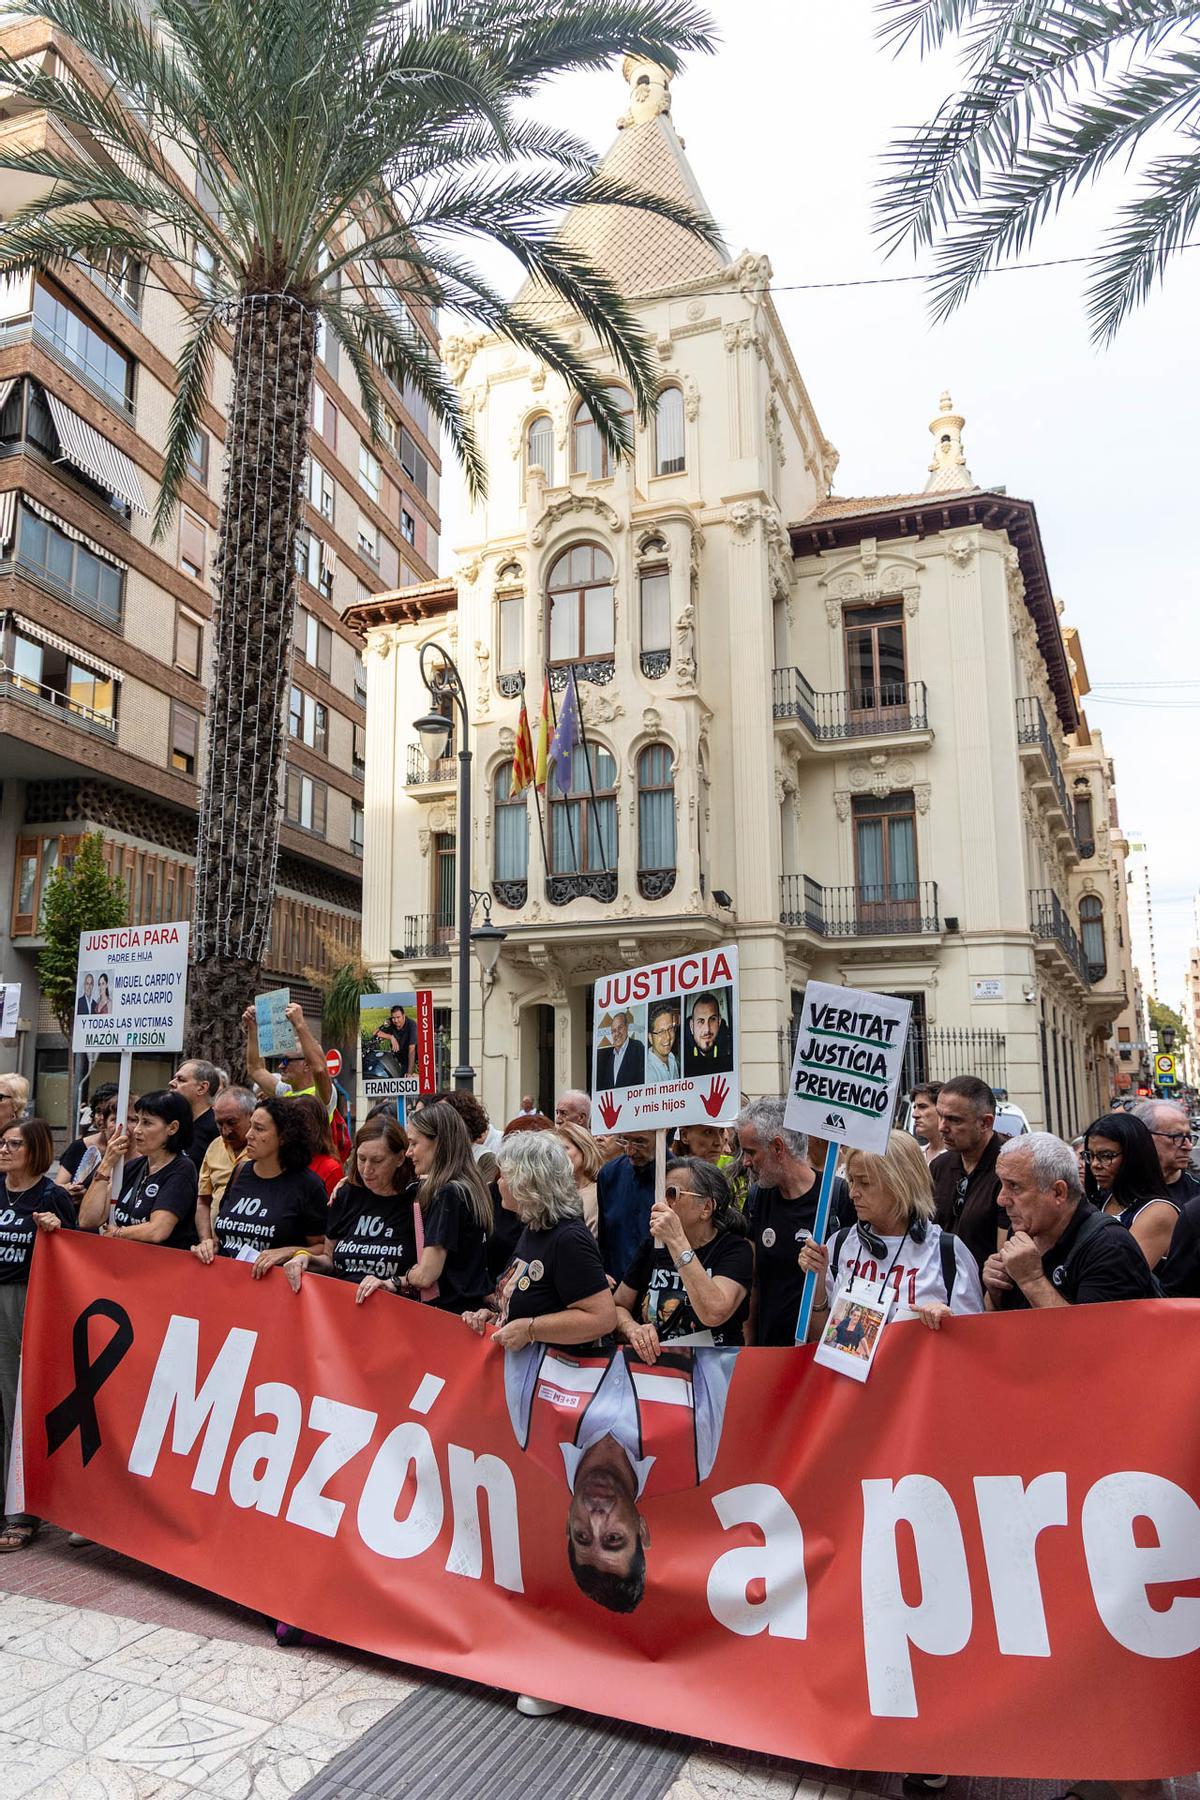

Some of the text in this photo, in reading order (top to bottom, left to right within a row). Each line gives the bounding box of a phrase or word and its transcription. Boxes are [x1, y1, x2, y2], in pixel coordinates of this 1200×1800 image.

[86, 928, 179, 951] JUSTICIA PARA
[108, 951, 153, 963] PADRE E HIJA
[115, 972, 182, 989] MIGUEL CARPIO Y
[598, 953, 733, 1009] JUSTICIA
[121, 991, 173, 1006] SARA CARPIO
[81, 1016, 173, 1029] Y TODAS LAS VICTIMAS
[810, 1003, 901, 1042] VERITAT
[86, 1029, 165, 1046] MAZÓN PRISIÓN
[421, 992, 431, 1090] JUSTICIA
[801, 1038, 888, 1078] JUSTÍCIA
[365, 1080, 418, 1095] FRANCISCO
[627, 1080, 694, 1101] por mi marido
[795, 1070, 889, 1112] PREVENCIÓ
[634, 1098, 686, 1117] y mis hijos
[230, 1197, 268, 1217] NO a
[354, 1215, 394, 1238] NO a
[345, 1257, 399, 1277] MAZÓN
[128, 1314, 1200, 1718] Mazón a pre
